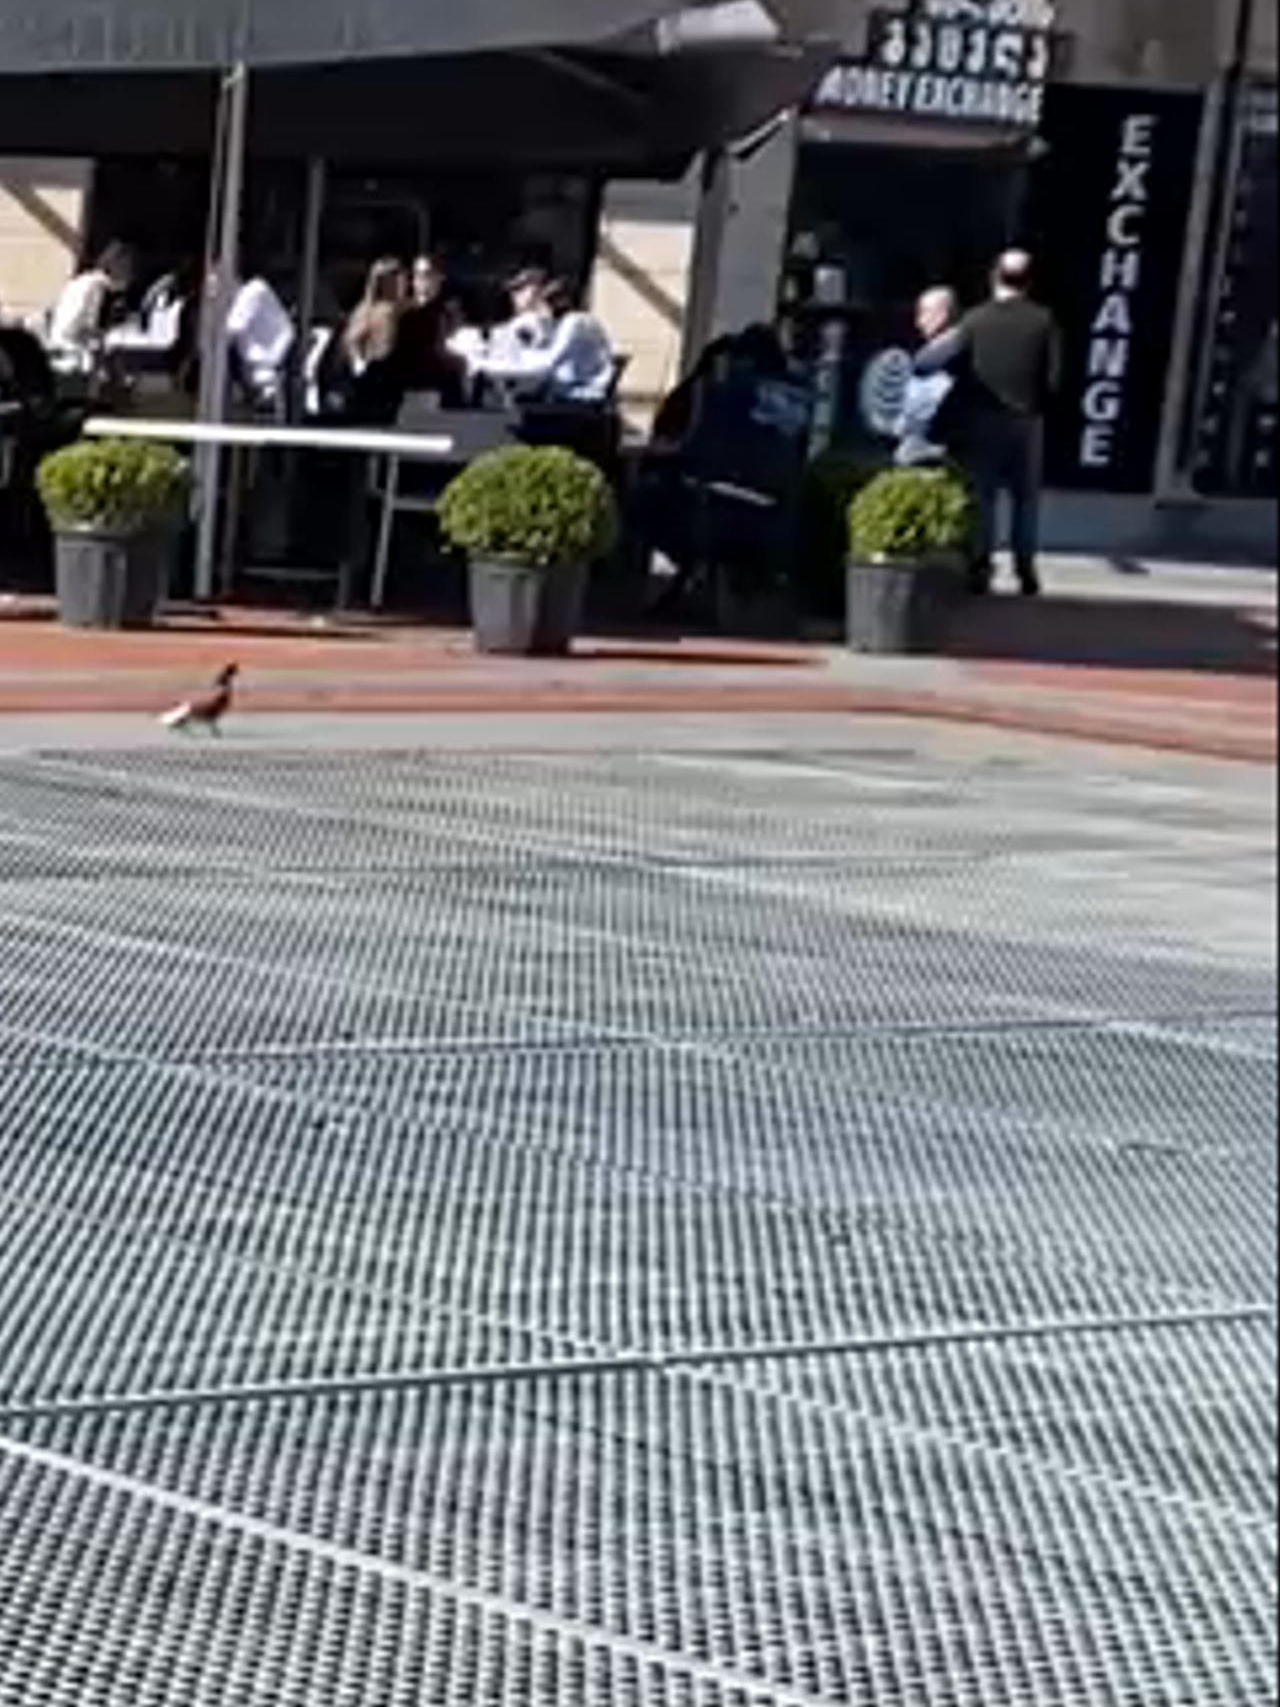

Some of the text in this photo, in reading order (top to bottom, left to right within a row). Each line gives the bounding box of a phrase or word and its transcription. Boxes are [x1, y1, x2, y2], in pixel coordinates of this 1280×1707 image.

[815, 66, 1045, 125] MONEY EXCHANGE
[1079, 114, 1158, 467] EXCHANGE
